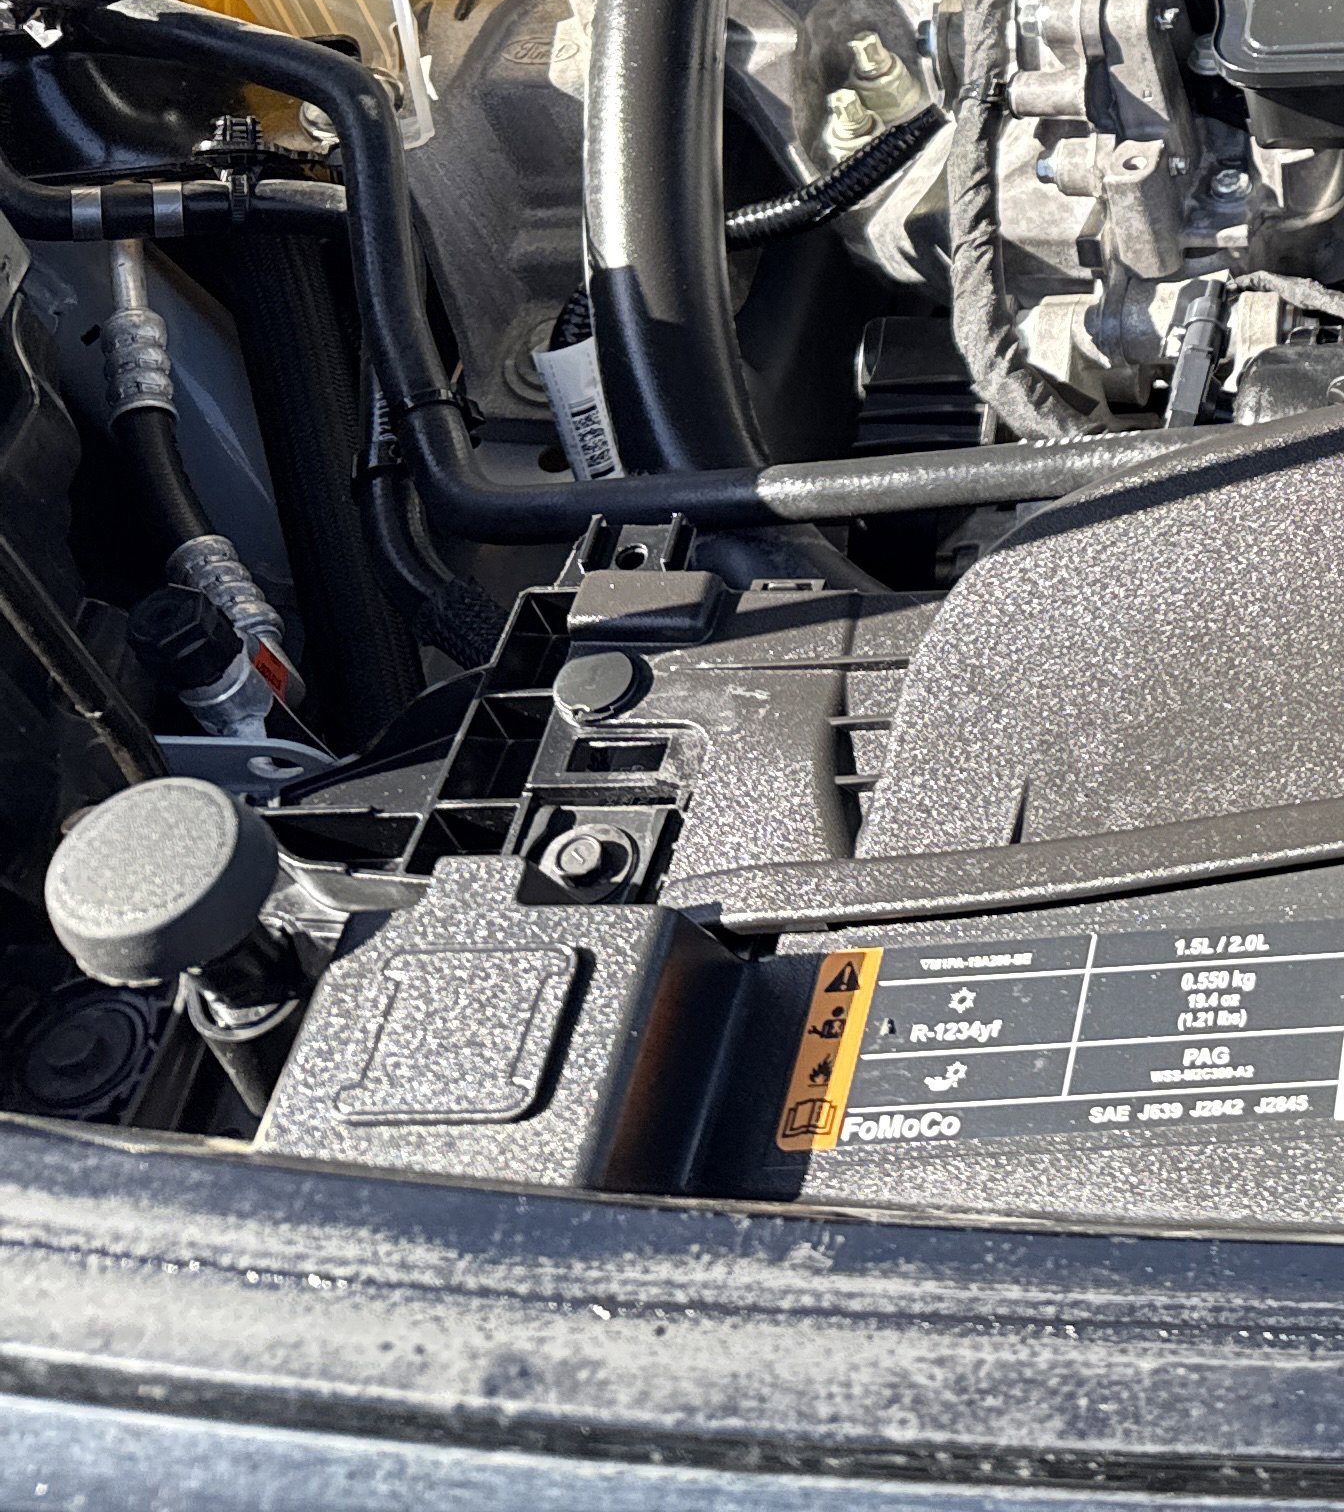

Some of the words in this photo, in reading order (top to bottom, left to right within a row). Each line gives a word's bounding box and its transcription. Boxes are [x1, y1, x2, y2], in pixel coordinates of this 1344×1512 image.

[1174, 937, 1214, 956] 1.5L
[1215, 935, 1227, 954] /
[1228, 933, 1270, 953] 2.0L
[1180, 970, 1229, 991] 0.550
[1231, 969, 1257, 992] kg
[1187, 992, 1219, 1009] 19.4
[1220, 993, 1242, 1008] oz
[909, 1018, 1003, 1043] R-1234yf
[1177, 1010, 1215, 1032] (1.21
[1216, 1008, 1248, 1028] lbs)
[1182, 1046, 1231, 1067] PAG
[1088, 1104, 1132, 1124] SAE
[1137, 1102, 1183, 1122] J639
[1189, 1098, 1245, 1118] J2842
[1254, 1094, 1309, 1115] J2845
[840, 1111, 961, 1143] FoMoCo
